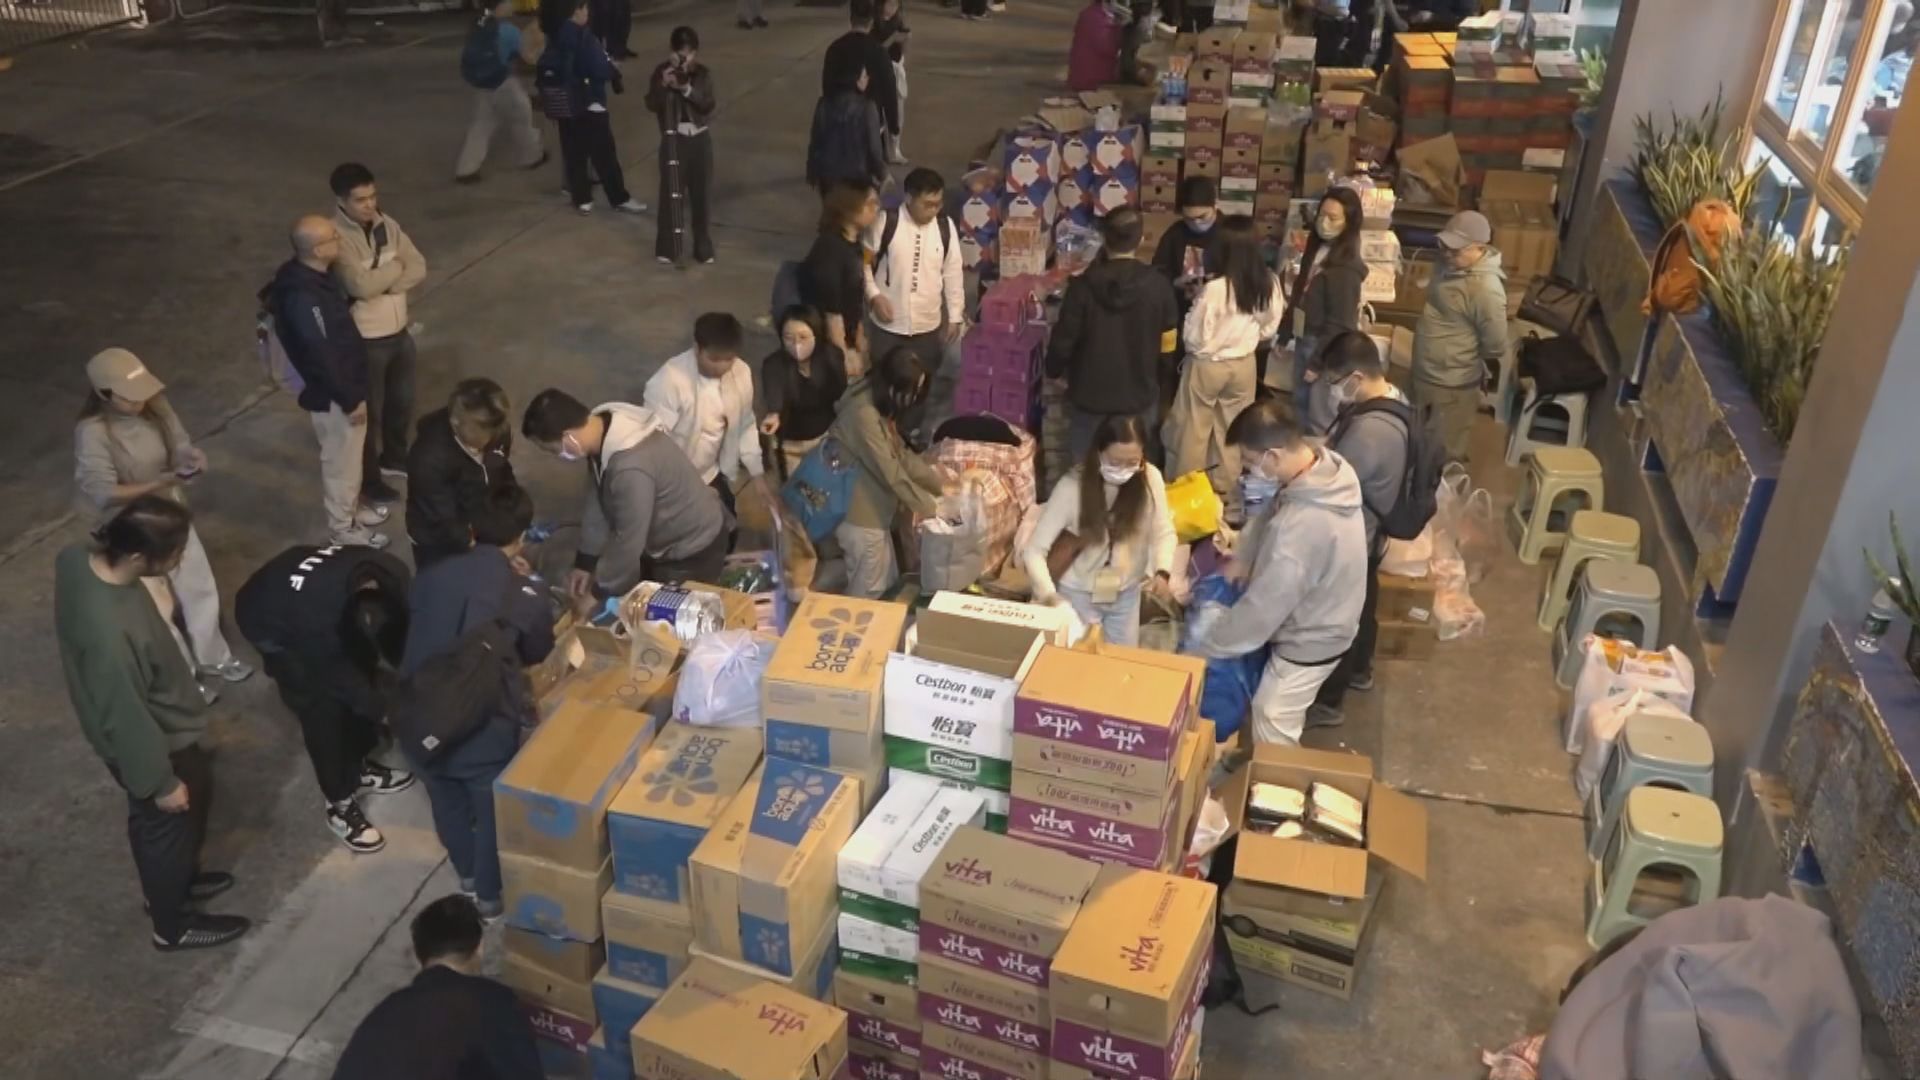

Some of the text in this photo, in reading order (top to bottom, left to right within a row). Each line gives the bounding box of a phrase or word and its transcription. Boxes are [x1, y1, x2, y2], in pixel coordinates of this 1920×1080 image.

[915, 673, 967, 694] Cestbon
[1035, 711, 1083, 738] vita
[1097, 724, 1146, 751] vita
[1029, 808, 1135, 848] vita vita
[945, 858, 992, 885] vita
[939, 932, 1043, 979] vita vita
[1119, 936, 1160, 972] vita
[529, 1012, 575, 1040] vita
[759, 1004, 805, 1036] vita
[858, 1019, 901, 1047] vita
[937, 1002, 1040, 1048] vita vita
[1080, 1036, 1137, 1070] vita
